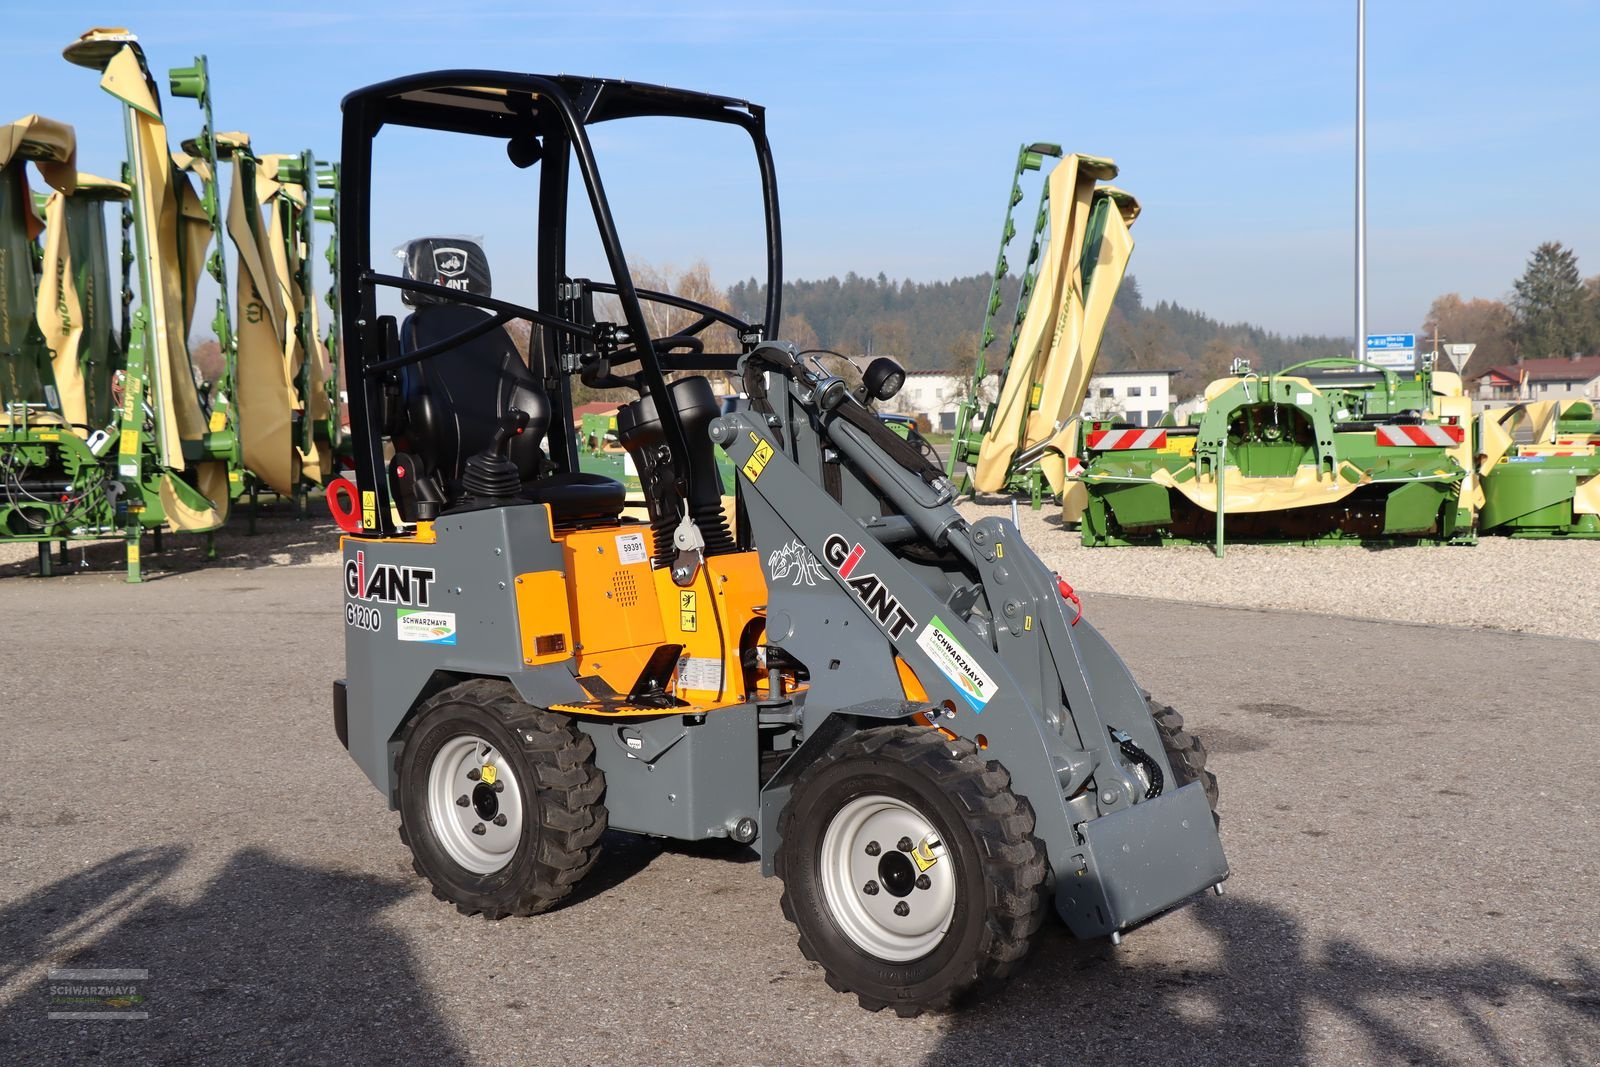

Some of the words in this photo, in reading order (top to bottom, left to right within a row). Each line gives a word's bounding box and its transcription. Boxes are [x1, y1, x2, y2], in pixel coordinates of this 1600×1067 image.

[624, 542, 643, 552] 59391
[346, 602, 382, 632] G1200
[402, 616, 448, 627] SCHWARZMAYR
[932, 629, 984, 688] SCHWARZMAYR
